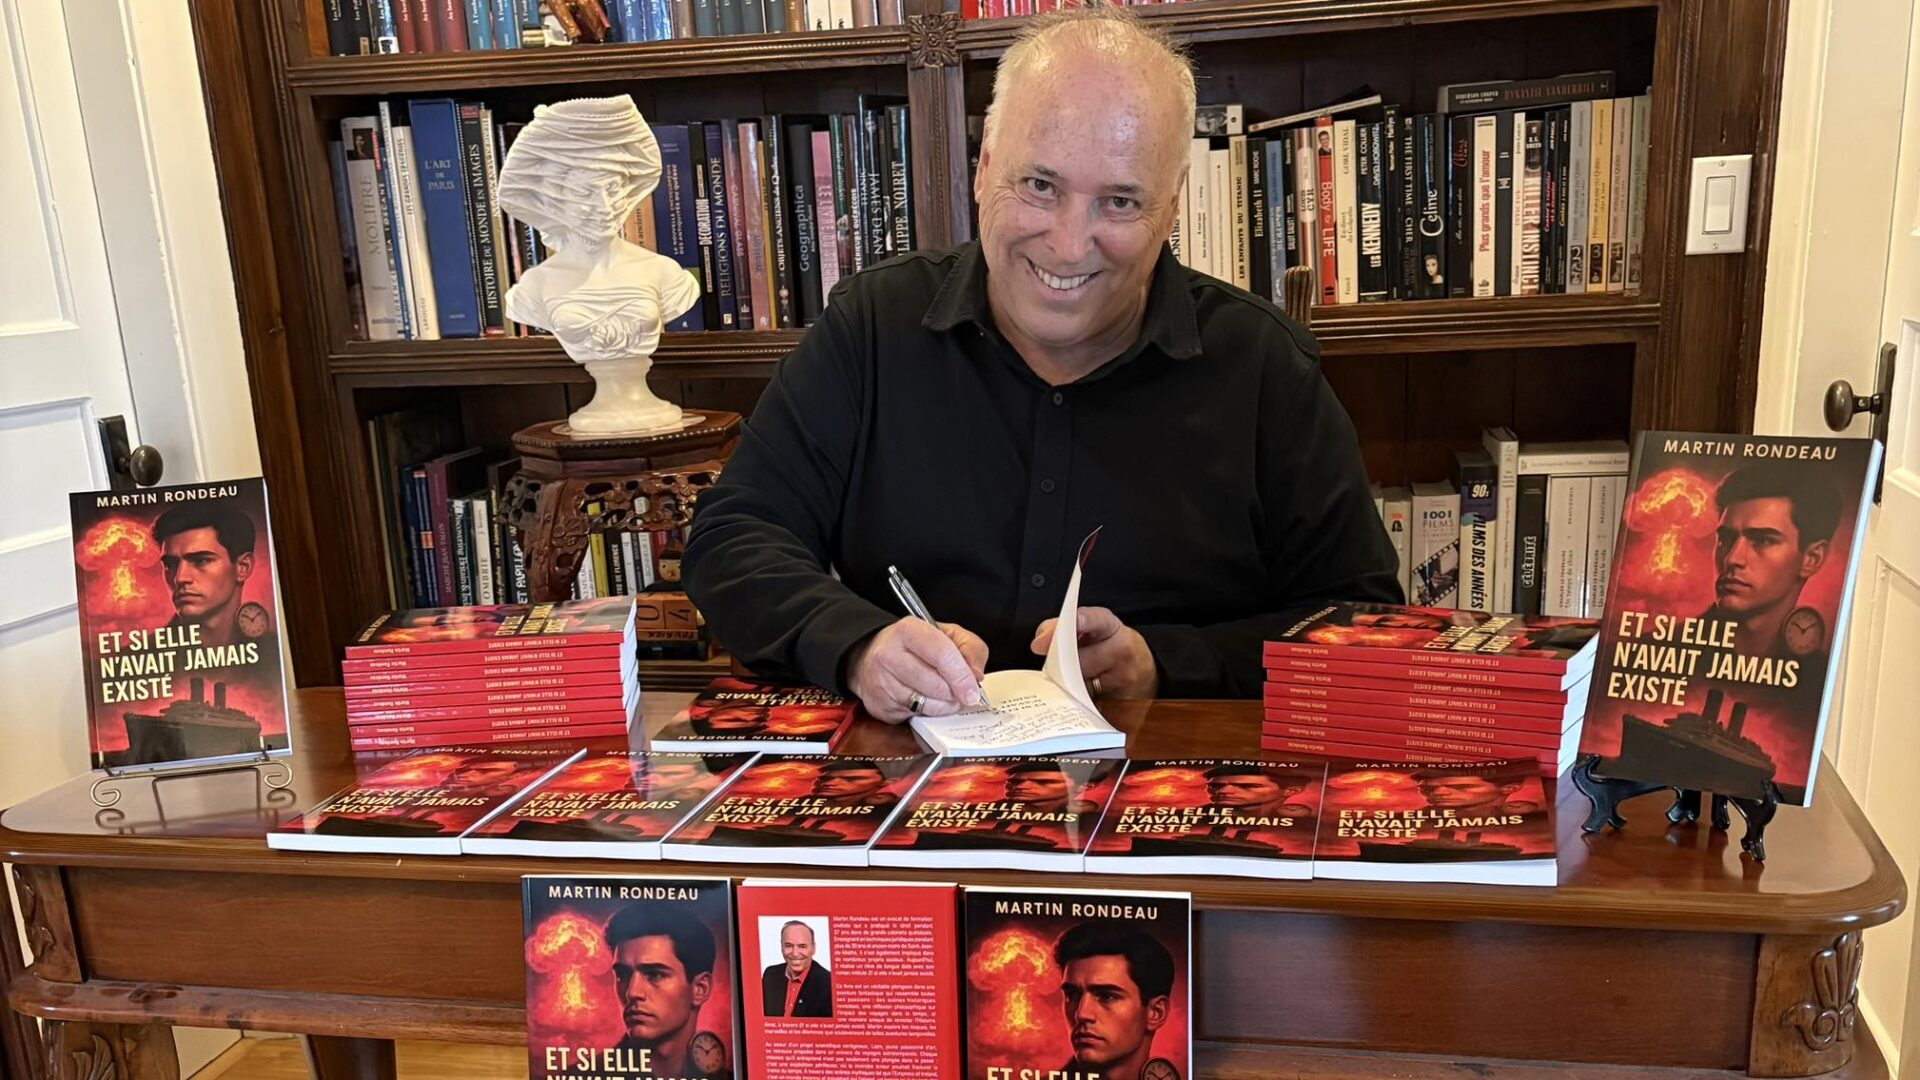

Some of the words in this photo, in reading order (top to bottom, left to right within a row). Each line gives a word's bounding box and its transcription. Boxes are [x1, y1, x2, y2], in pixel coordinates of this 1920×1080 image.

[1341, 125, 1349, 151] VIDAL
[1372, 123, 1380, 164] HOROWITZ
[1404, 135, 1413, 153] THE
[424, 160, 451, 170] L'ART
[468, 144, 484, 187] IMAGES
[1360, 157, 1368, 175] PETER
[1404, 155, 1413, 181] FIRST
[1476, 150, 1491, 183] l'amour
[428, 182, 455, 190] PARIS
[710, 157, 724, 206] MONDE
[859, 167, 868, 205] TITANIC
[891, 160, 907, 209] NOIRET
[1235, 176, 1243, 208] TITANIC
[1481, 184, 1492, 200] que
[868, 172, 882, 215] JAMES
[1307, 188, 1315, 211] CYR
[1319, 182, 1331, 211] Body
[1404, 183, 1413, 206] TIME
[1524, 177, 1541, 224] KILLER
[476, 201, 491, 244] MONDE
[715, 210, 726, 228] DU
[794, 184, 811, 272] Geographica
[1237, 212, 1243, 224] DU
[1255, 199, 1264, 237] Elizabeth
[1481, 202, 1492, 231] grands
[872, 218, 885, 255] DEAN
[1361, 202, 1381, 255] KENNEDY
[1405, 217, 1414, 243] CHER
[1322, 227, 1335, 256] LIFE
[1479, 233, 1491, 252] Plus
[716, 232, 732, 296] RELIGIONS
[1370, 256, 1382, 267] LES
[1522, 229, 1540, 291] INSTINCT
[482, 259, 498, 309] HISTOIRE
[1664, 439, 1734, 455] MARTIN
[1743, 443, 1838, 461] RONDEAU
[97, 493, 157, 508] MARTIN
[164, 485, 238, 502] RONDEAU
[1423, 519, 1454, 528] FILMS
[1424, 511, 1452, 519] 1001
[611, 544, 621, 573] FLORENCE
[1472, 548, 1485, 568] DES
[1521, 535, 1537, 588] CÉLÉBRITÉ
[482, 558, 491, 599] OMBRIE
[1471, 569, 1488, 609] ANNÉES
[518, 591, 528, 604] ET
[99, 632, 122, 654] ET
[129, 630, 149, 650] SI
[156, 624, 200, 648] ELLE
[1618, 611, 1644, 638] ET
[1653, 614, 1675, 641] SI
[1681, 618, 1738, 648] ELLE
[100, 651, 176, 678] N'AVAIT
[184, 642, 259, 670] JAMAIS
[1612, 642, 1700, 676] N'AVAIT
[1706, 654, 1800, 688] JAMAIS
[102, 676, 174, 703] EXISTÉ
[1607, 672, 1688, 707] EXISTÉ
[605, 750, 661, 758] MARTIN
[664, 751, 734, 759] RONDEAU
[964, 756, 1022, 764] MARTIN
[1028, 757, 1101, 765] RONDEAU
[1155, 759, 1216, 767] MARTIN
[1222, 759, 1299, 769] RONDEAU
[1356, 761, 1422, 769] MARTIN
[1427, 760, 1508, 769] RONDEAU
[336, 796, 411, 805] N'AVAIT
[411, 796, 489, 806] JAMAIS
[347, 789, 378, 797] ET
[381, 789, 402, 797] SI
[404, 789, 447, 797] ELLE
[537, 791, 566, 800] ET
[592, 793, 637, 801] ELLE
[722, 796, 751, 806] ET
[753, 797, 777, 807] SI
[779, 798, 827, 808] ELLE
[524, 800, 600, 809] N'AVAIT
[604, 800, 680, 810] JAMAIS
[714, 805, 796, 815] N'AVAIT
[794, 805, 874, 815] JAMAIS
[911, 809, 993, 821] N'AVAIT
[1001, 811, 1078, 823] JAMAIS
[917, 801, 946, 811] ET
[949, 802, 972, 811] SI
[975, 802, 1024, 812] ELLE
[1123, 806, 1152, 815] ET
[1155, 806, 1179, 816] SI
[1181, 807, 1234, 817] ELLE
[1339, 809, 1367, 819] ET
[1373, 810, 1398, 819] SI
[1401, 809, 1456, 819] ELLE
[1118, 815, 1204, 825] N'AVAIT
[1207, 815, 1294, 827] JAMAIS
[1338, 817, 1425, 829] N'AVAIT
[1430, 814, 1523, 829] JAMAIS
[549, 886, 612, 899] MARTIN
[620, 887, 699, 900] RONDEAU
[995, 901, 1063, 915] MARTIN
[1072, 904, 1158, 920] RONDEAU
[546, 1047, 570, 1071] ET
[577, 1047, 595, 1071] SI
[604, 1048, 652, 1072] ELLE
